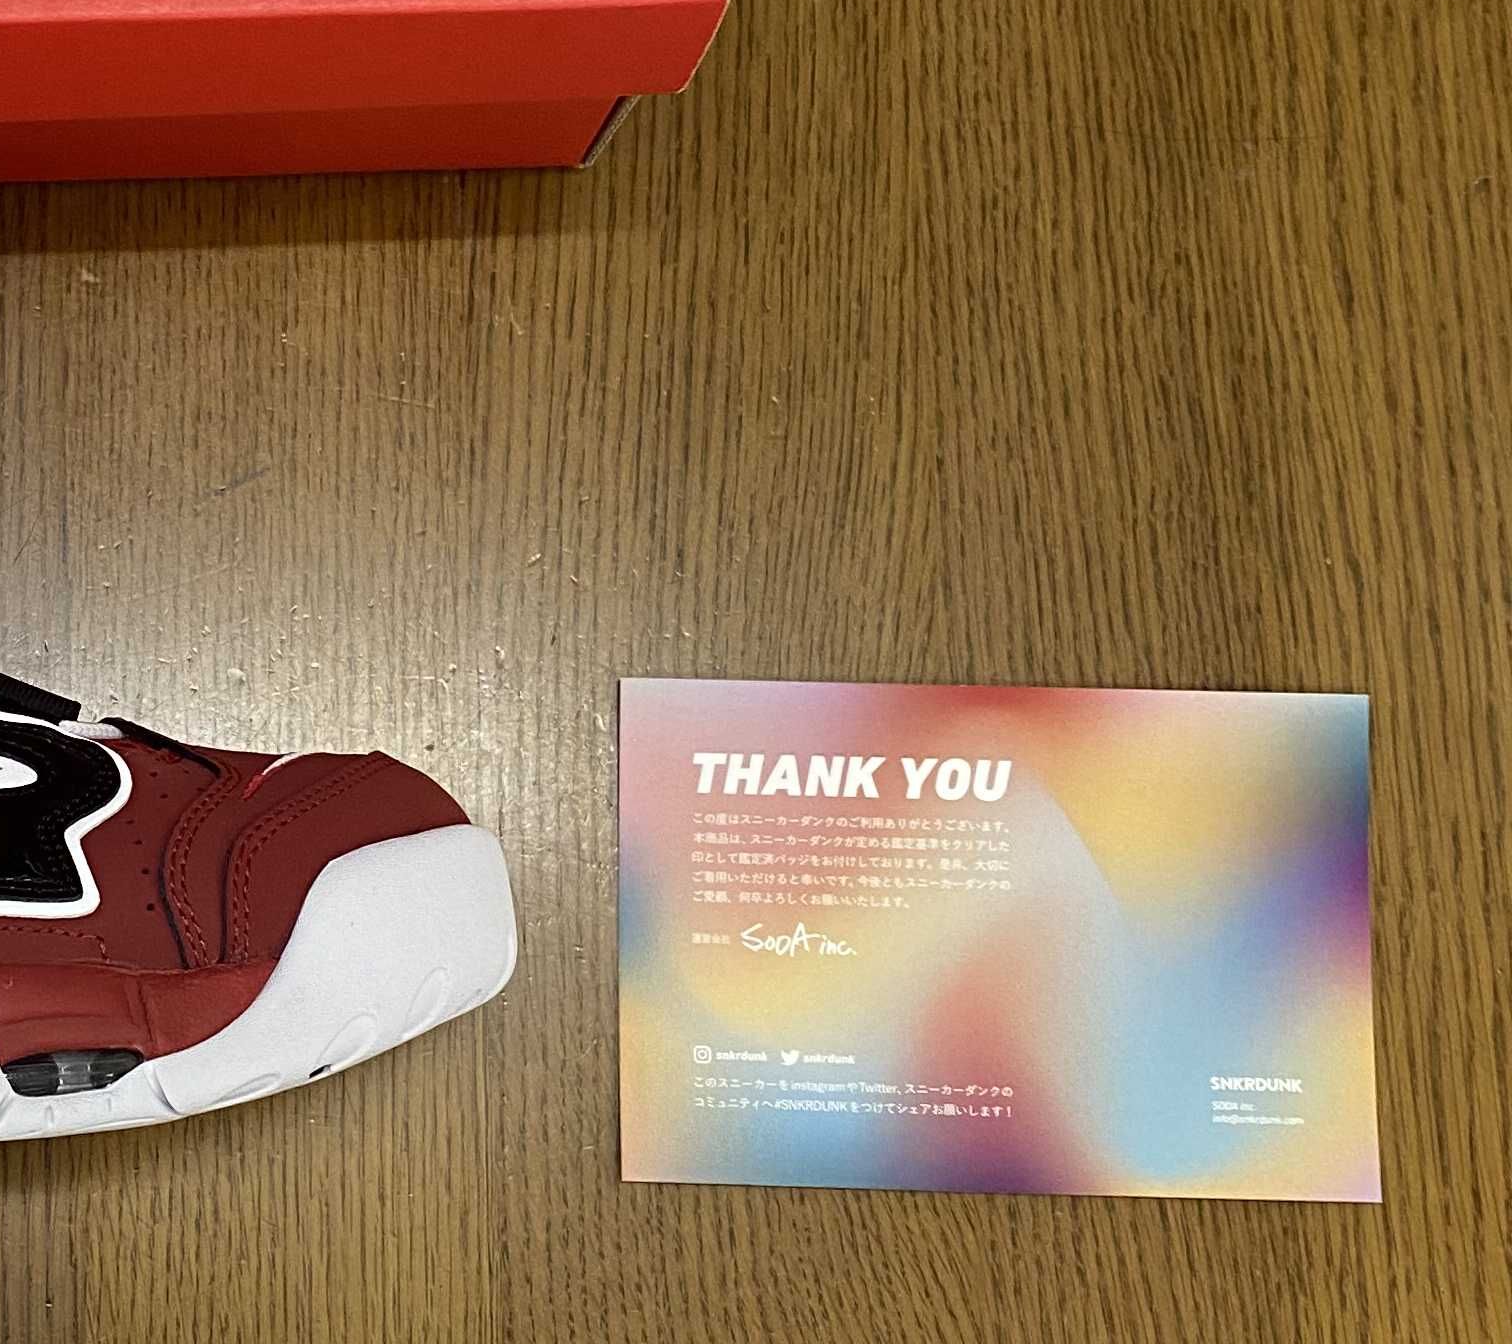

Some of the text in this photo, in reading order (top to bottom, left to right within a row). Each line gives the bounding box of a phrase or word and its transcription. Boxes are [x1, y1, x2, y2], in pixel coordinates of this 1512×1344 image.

[692, 753, 1012, 801] THANK YOU
[1209, 1076, 1304, 1094] SNKRDUNK
